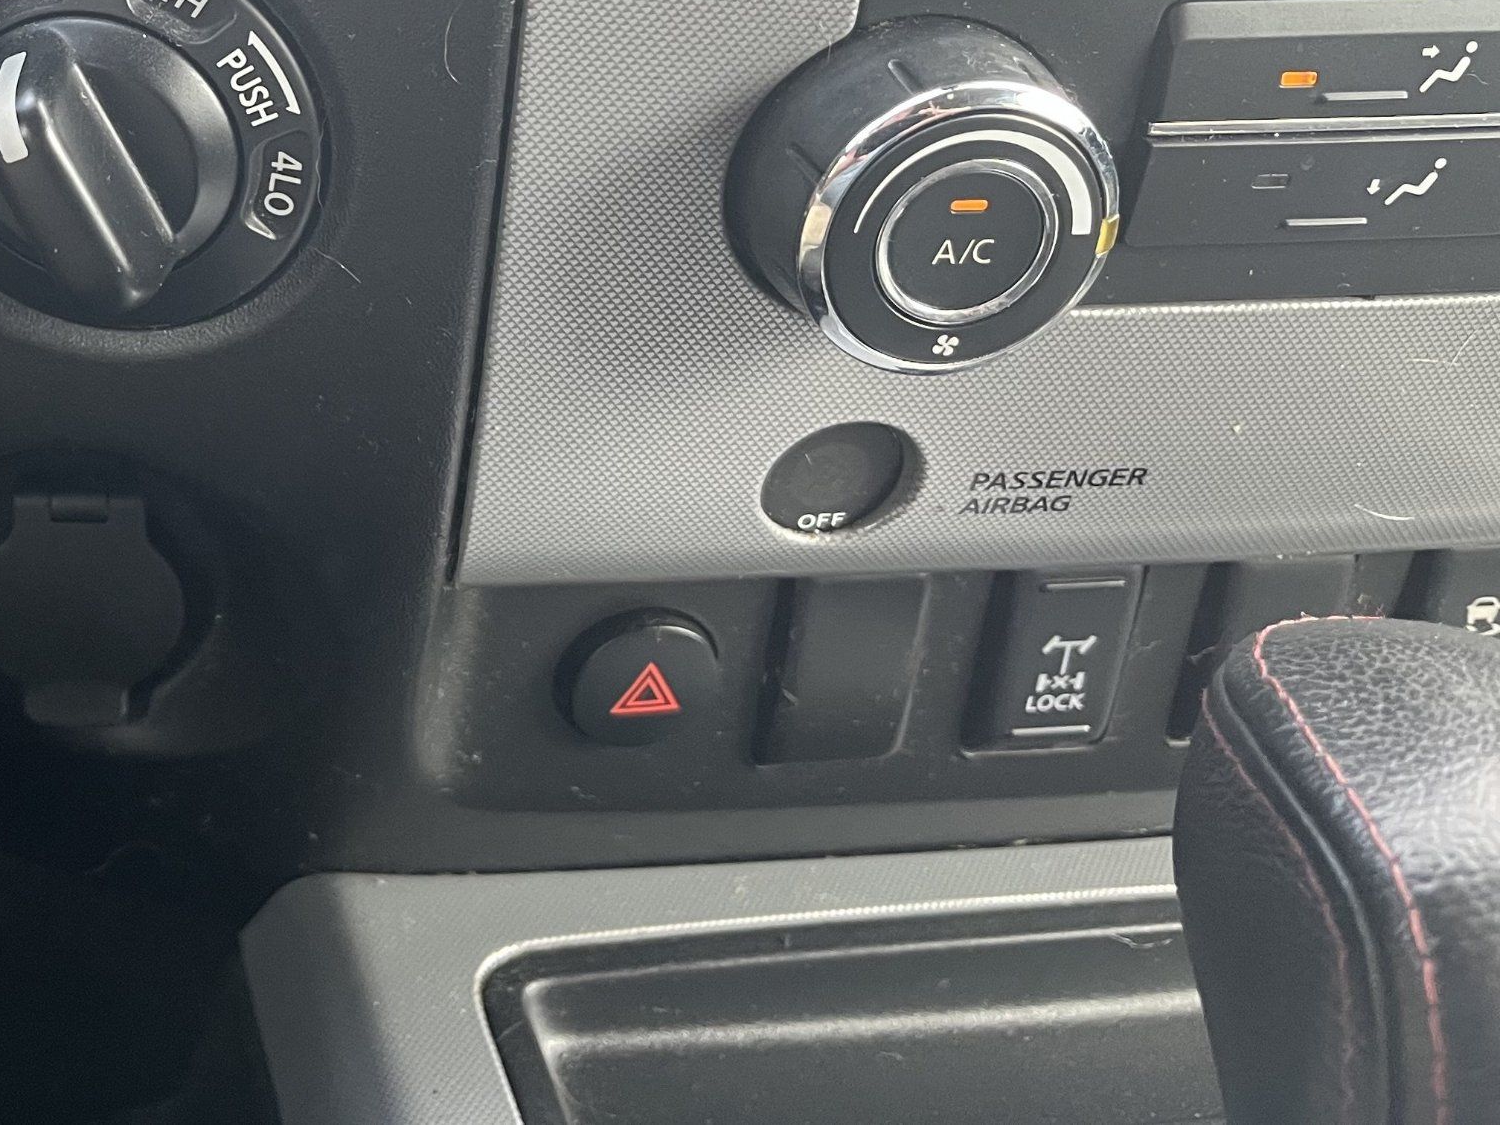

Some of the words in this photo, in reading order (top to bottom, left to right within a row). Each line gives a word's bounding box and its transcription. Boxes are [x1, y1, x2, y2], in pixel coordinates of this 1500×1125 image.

[215, 47, 279, 128] PUSH
[263, 150, 303, 217] 4LO
[931, 239, 995, 265] A/C
[969, 467, 1148, 492] PASSENGER
[959, 494, 1072, 516] AIRBAG
[797, 511, 847, 530] OFF
[1024, 693, 1086, 713] LOCK
